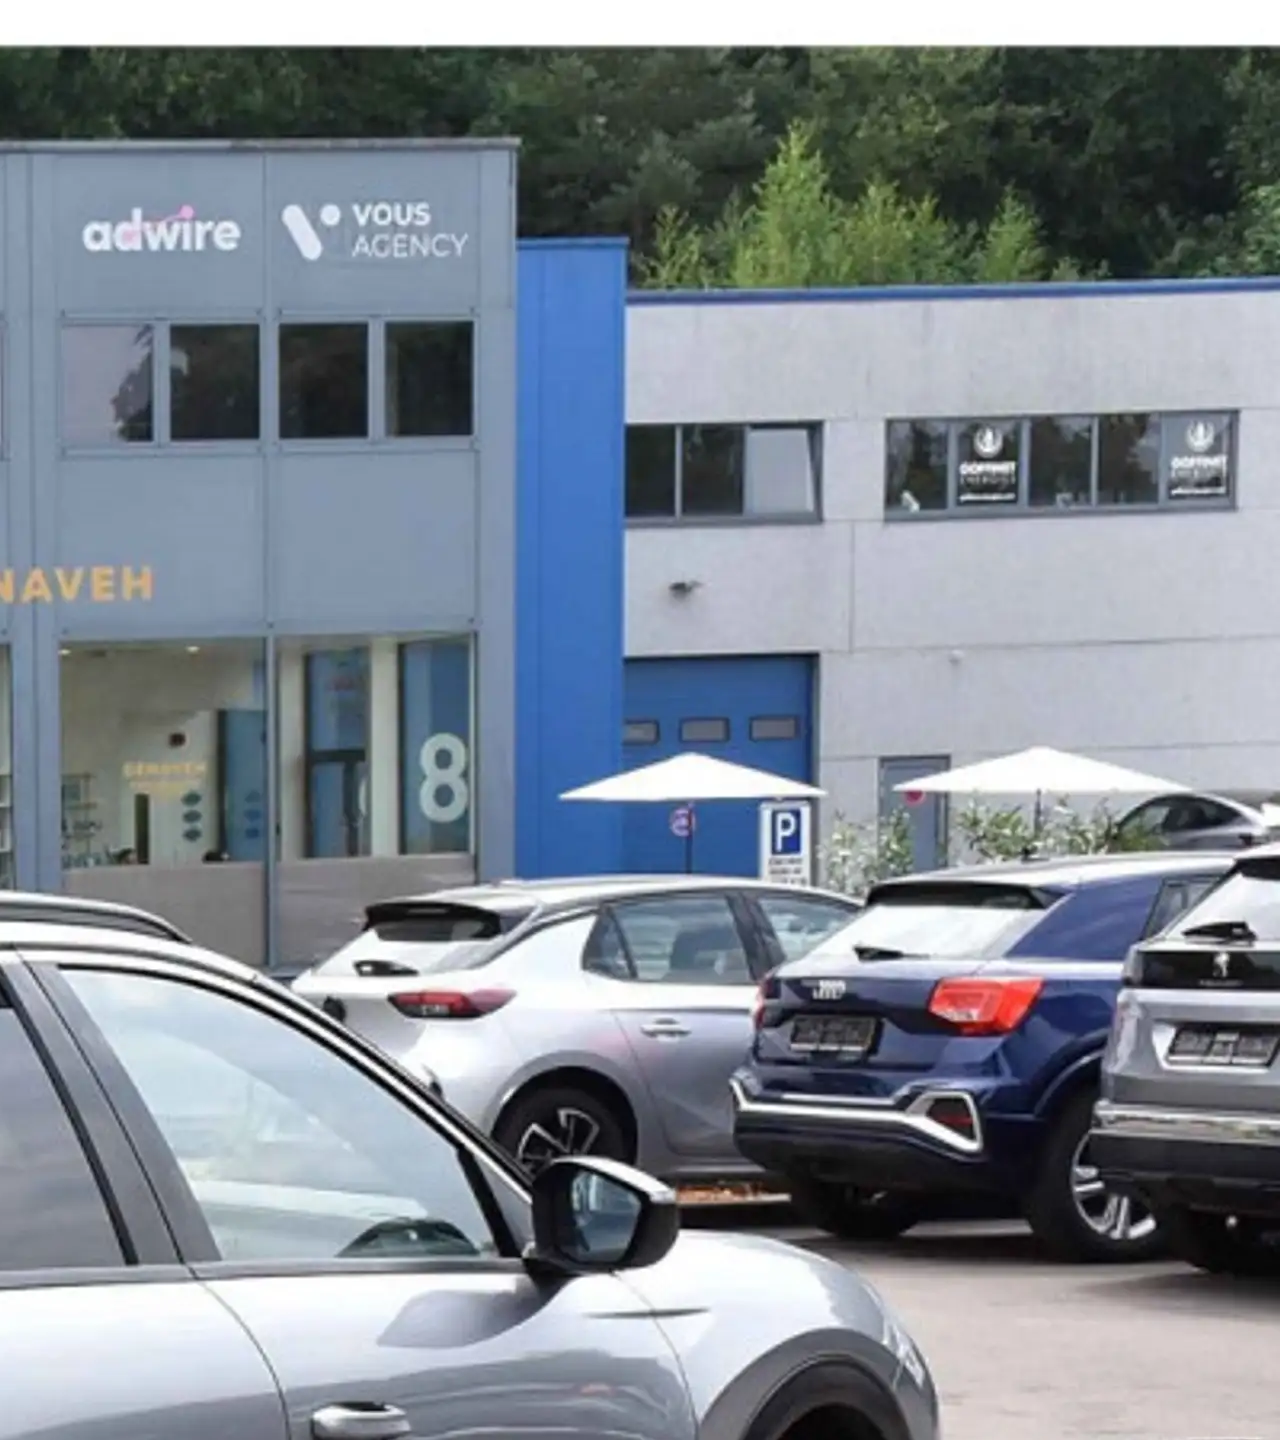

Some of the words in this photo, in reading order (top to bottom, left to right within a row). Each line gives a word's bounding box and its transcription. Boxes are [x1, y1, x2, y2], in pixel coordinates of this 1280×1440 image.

[82, 205, 241, 252] adwire
[352, 201, 432, 227] VOUS
[351, 232, 469, 259] AGENCY
[418, 732, 469, 824] 8
[775, 811, 797, 852] P
